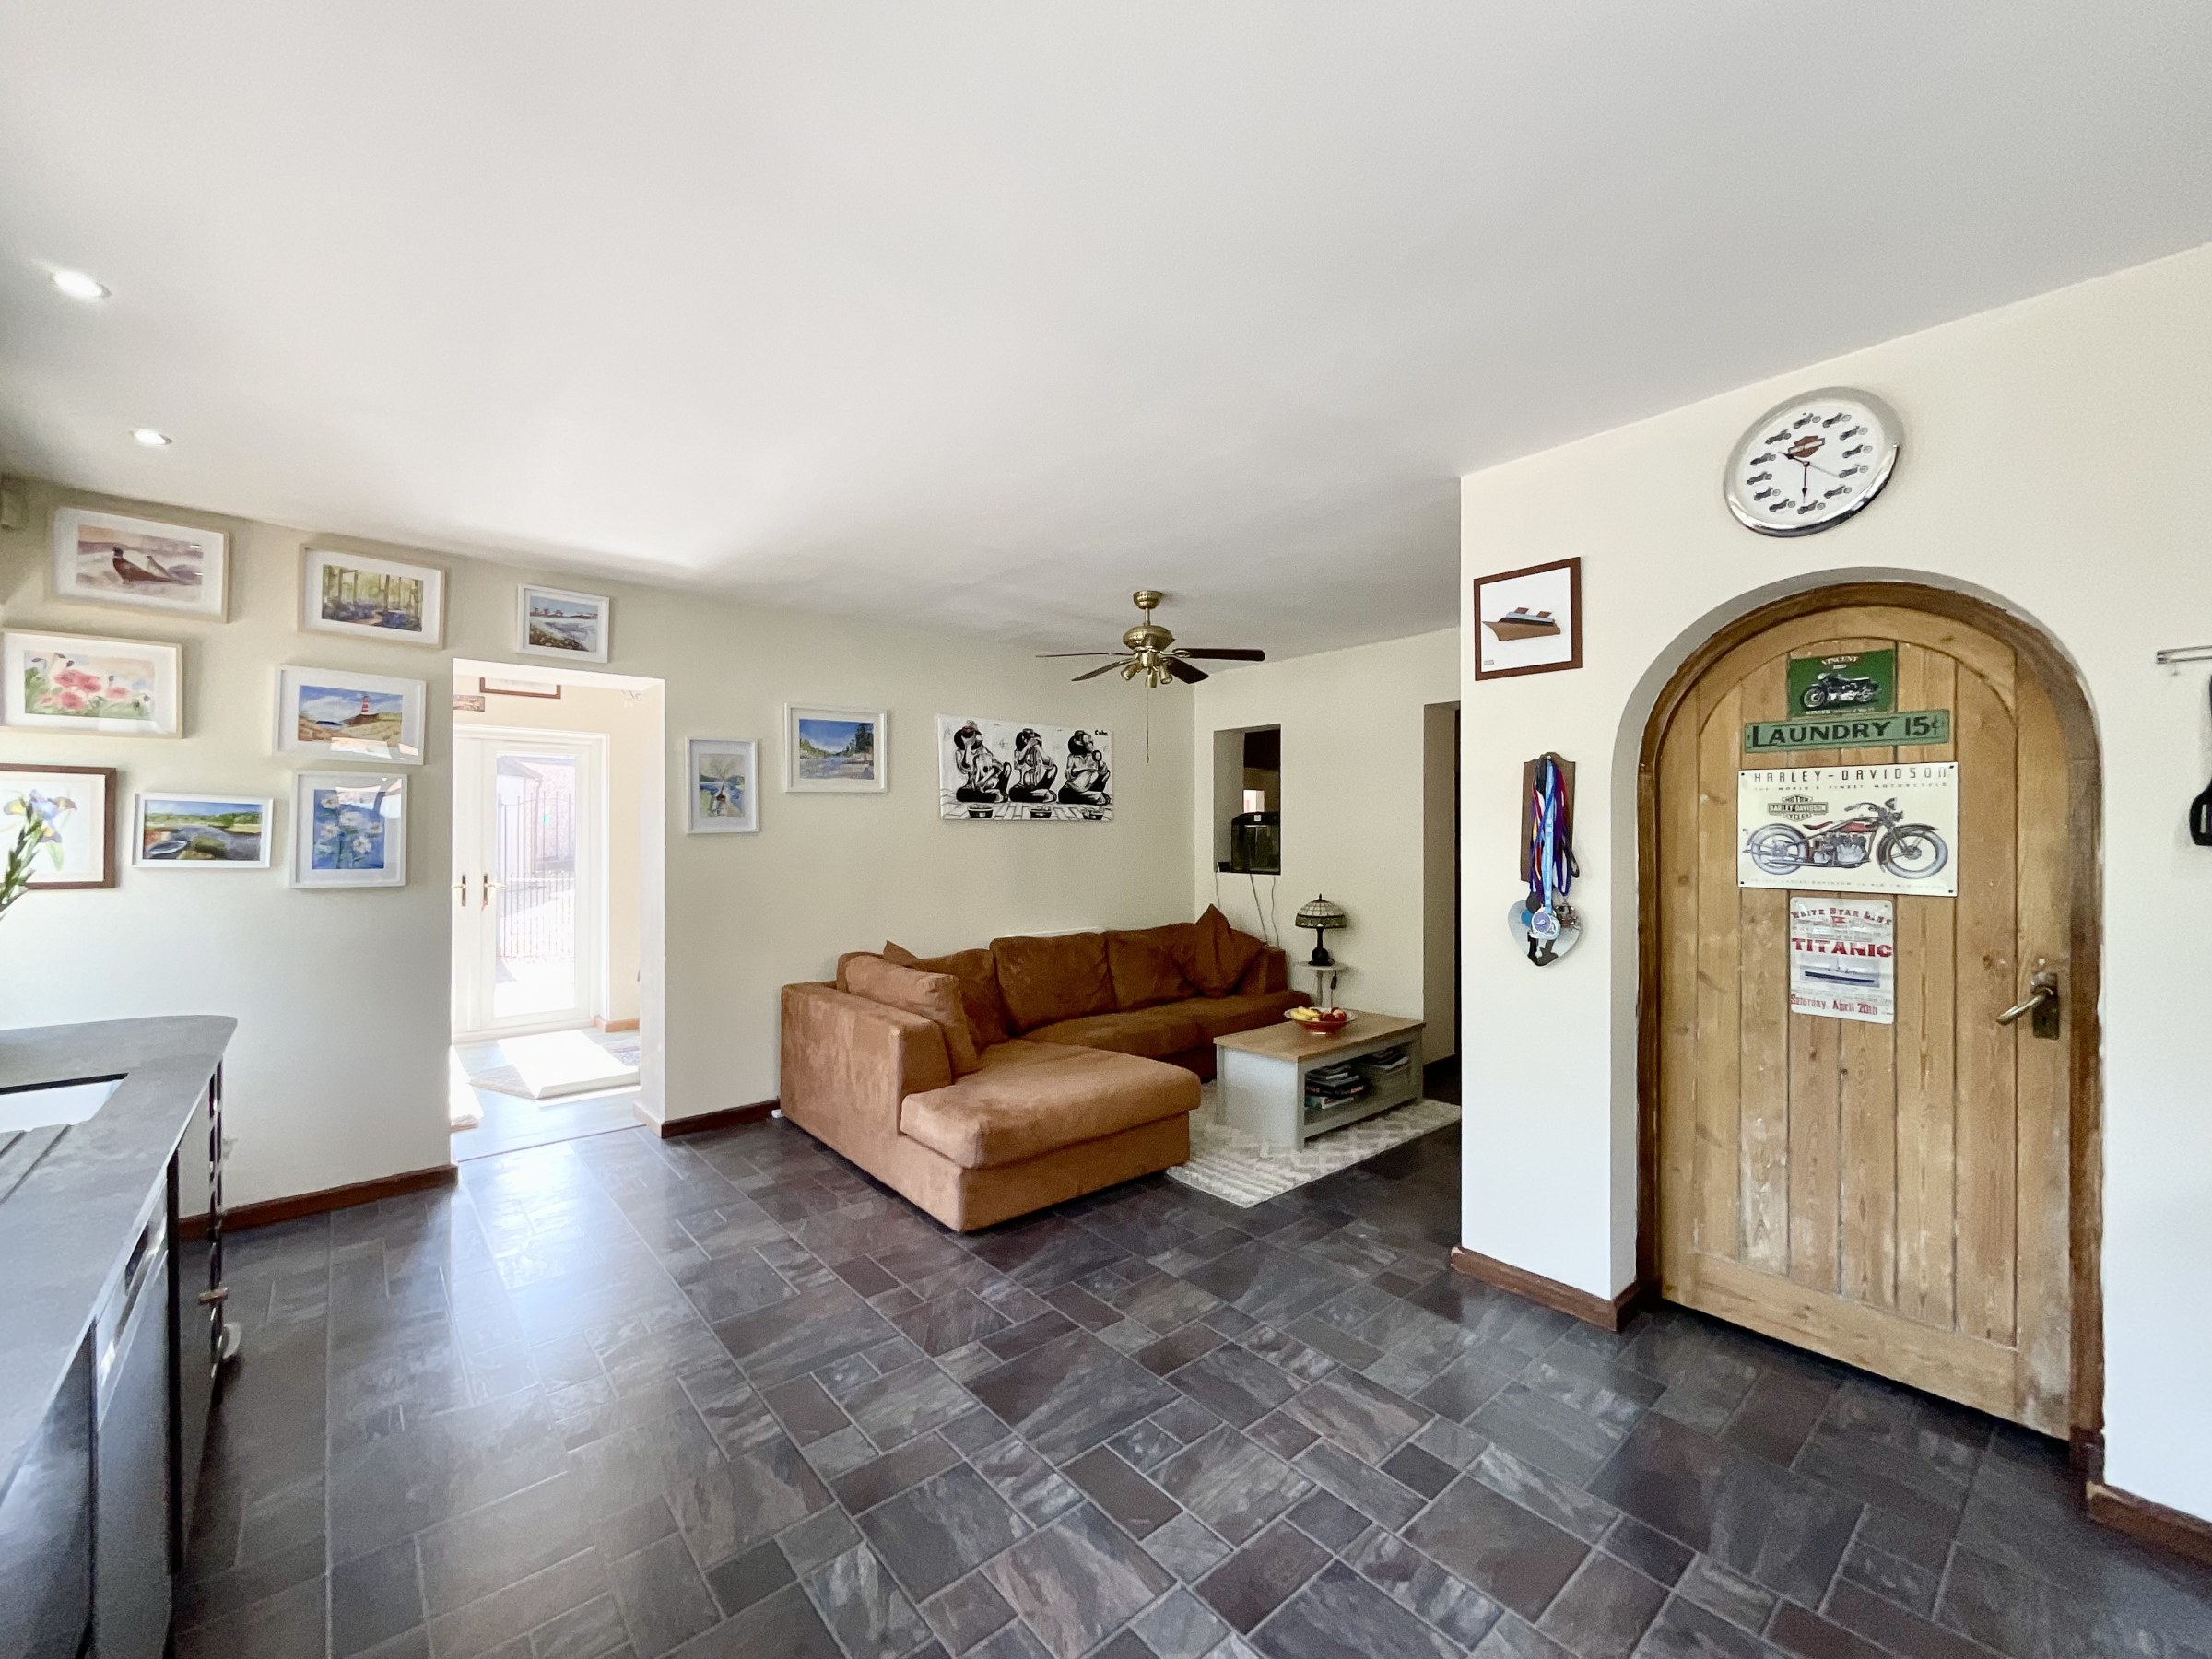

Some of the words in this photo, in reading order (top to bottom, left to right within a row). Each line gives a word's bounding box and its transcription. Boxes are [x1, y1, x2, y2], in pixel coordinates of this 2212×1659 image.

[1752, 720, 1891, 747] LAUNDRY
[1830, 907, 1860, 918] STAR
[1791, 937, 1893, 958] TITANIC
[1832, 1000, 1855, 1012] April
[1858, 1003, 1877, 1015] 20th
